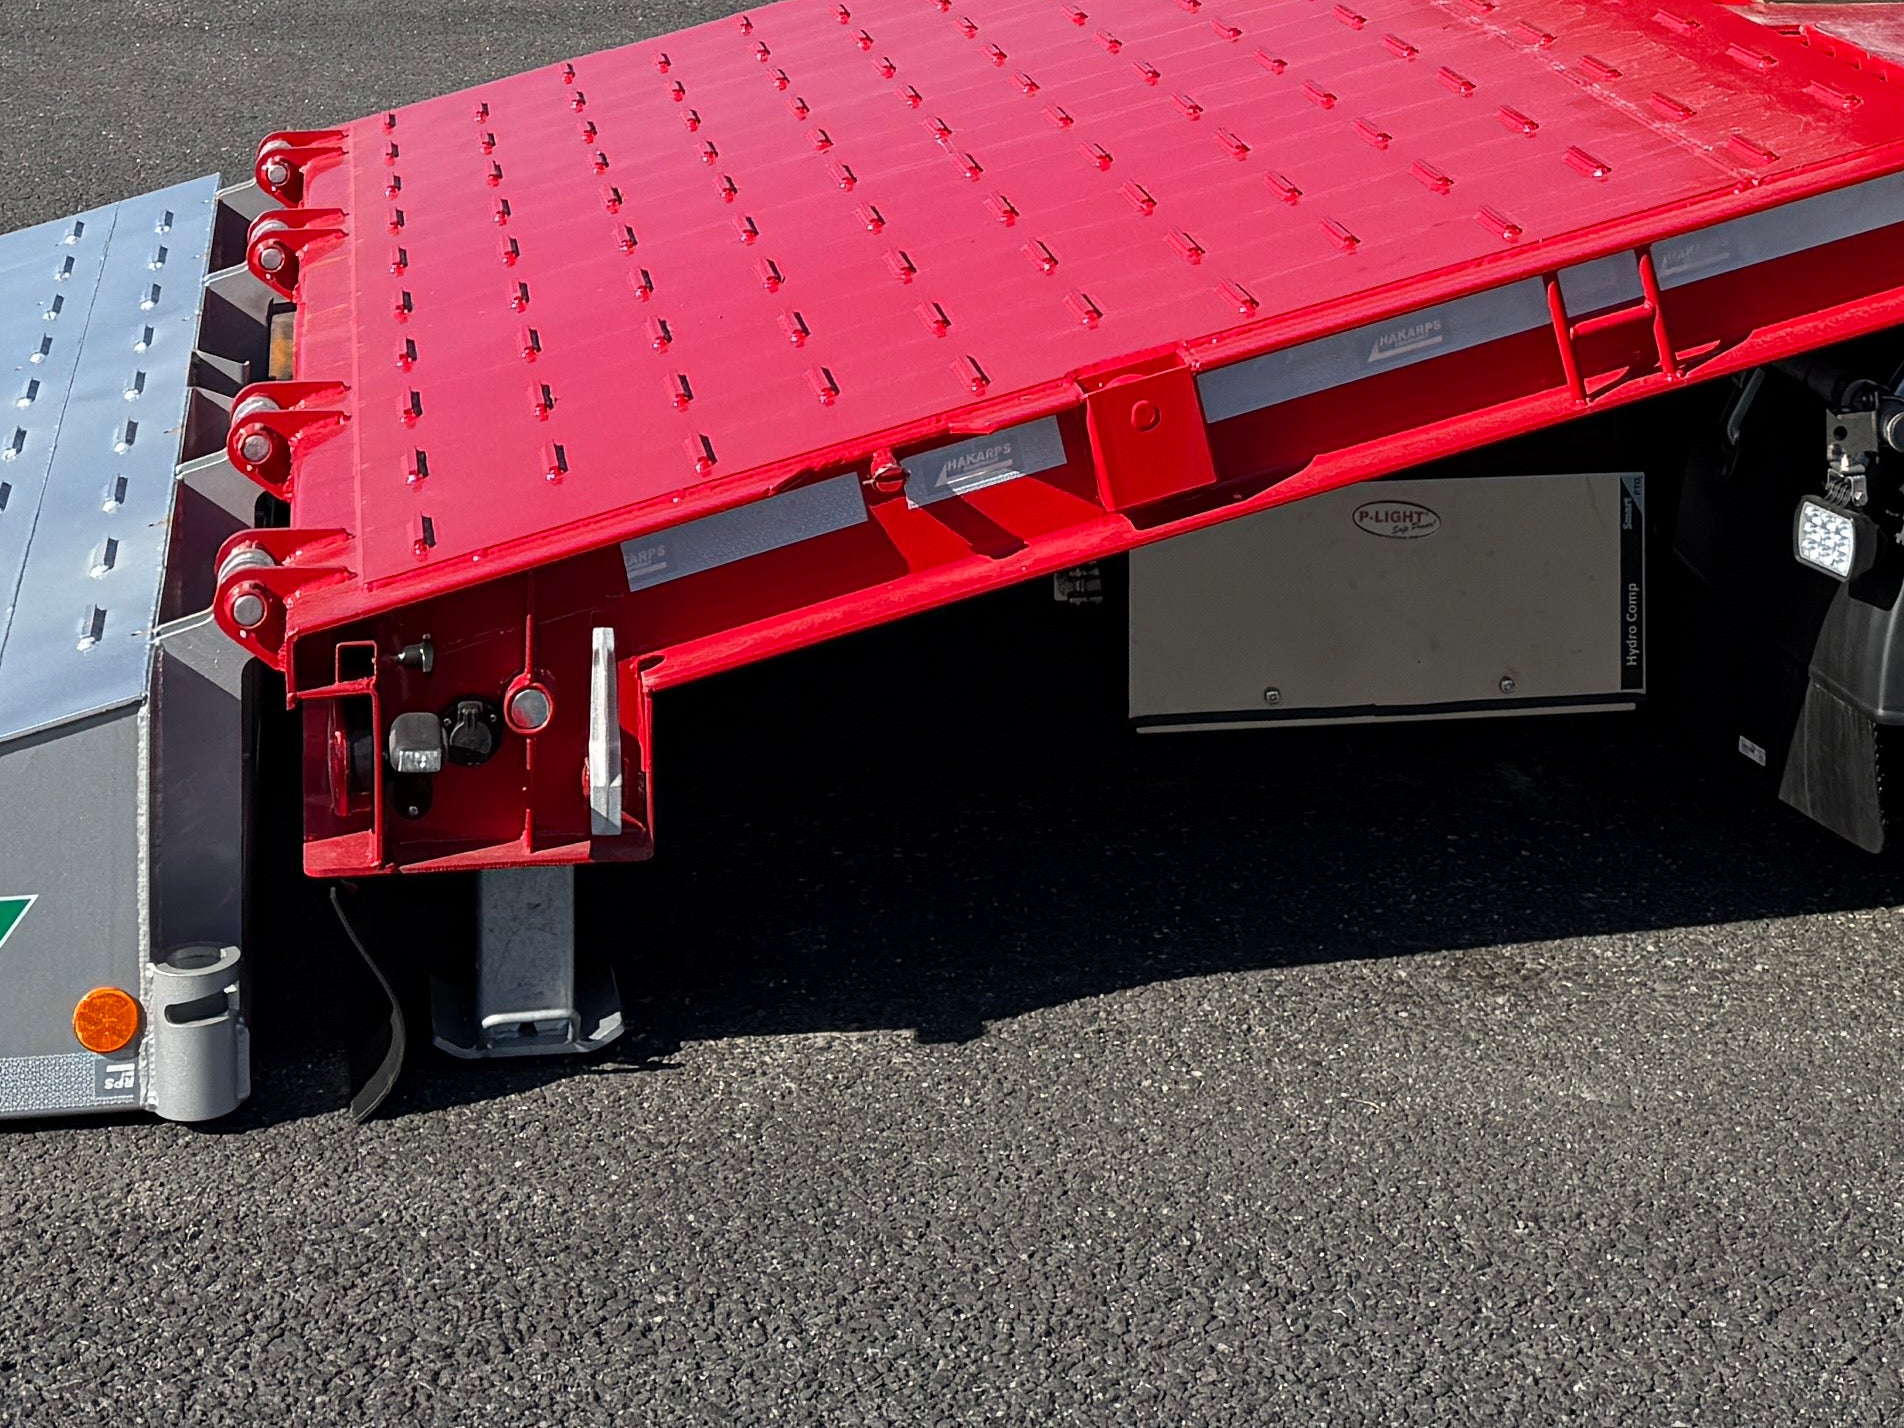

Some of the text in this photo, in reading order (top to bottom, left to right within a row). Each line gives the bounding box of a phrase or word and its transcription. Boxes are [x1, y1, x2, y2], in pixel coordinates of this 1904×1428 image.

[1379, 320, 1441, 347] HAKARPS
[947, 443, 1012, 472] HAKARPS
[1625, 583, 1640, 666] Hydro Comp
